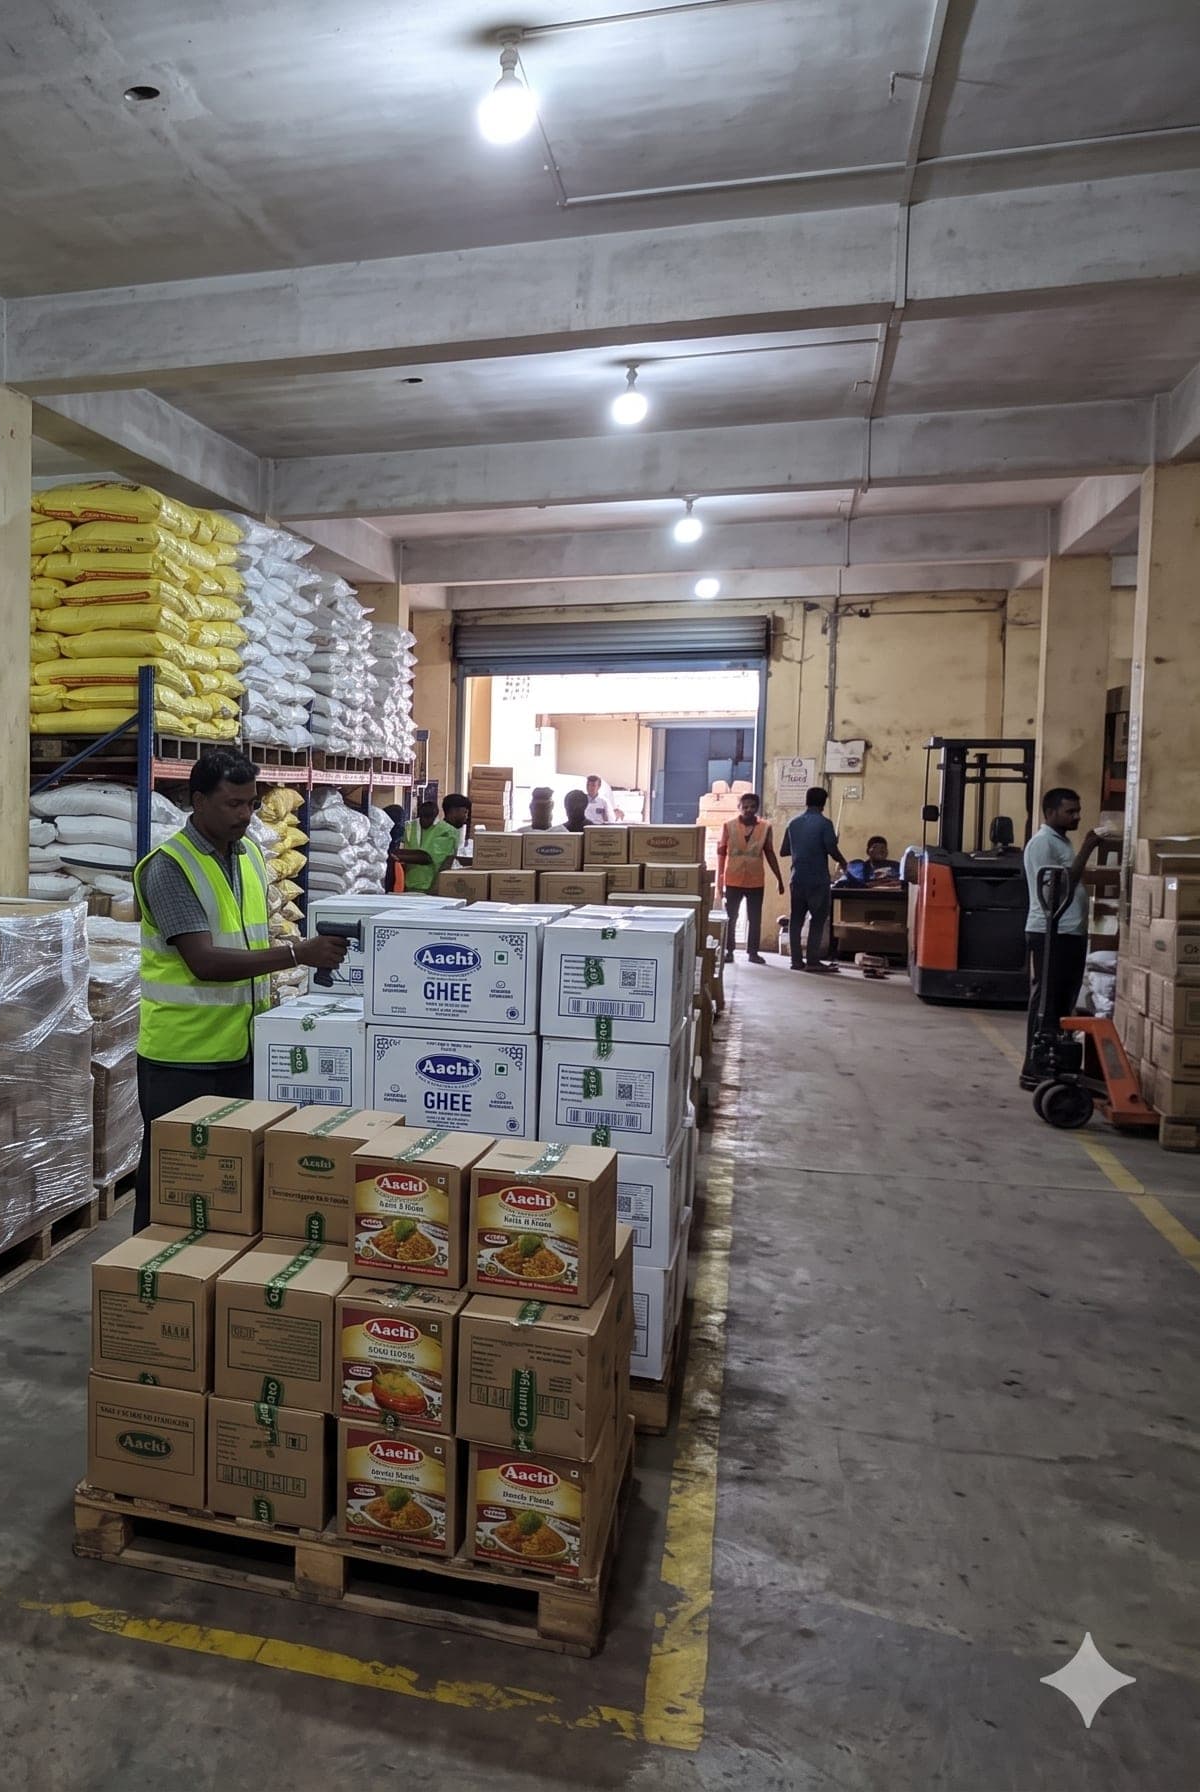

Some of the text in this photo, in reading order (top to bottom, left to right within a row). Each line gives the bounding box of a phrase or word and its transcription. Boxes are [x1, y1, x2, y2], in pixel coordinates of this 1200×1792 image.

[423, 981, 472, 1002] GHEE
[422, 1059, 475, 1077] Aachi
[424, 1091, 473, 1112] GHEE
[505, 1191, 551, 1207] Aachi
[370, 1322, 415, 1340] Aachi
[373, 1444, 420, 1461] Aachi
